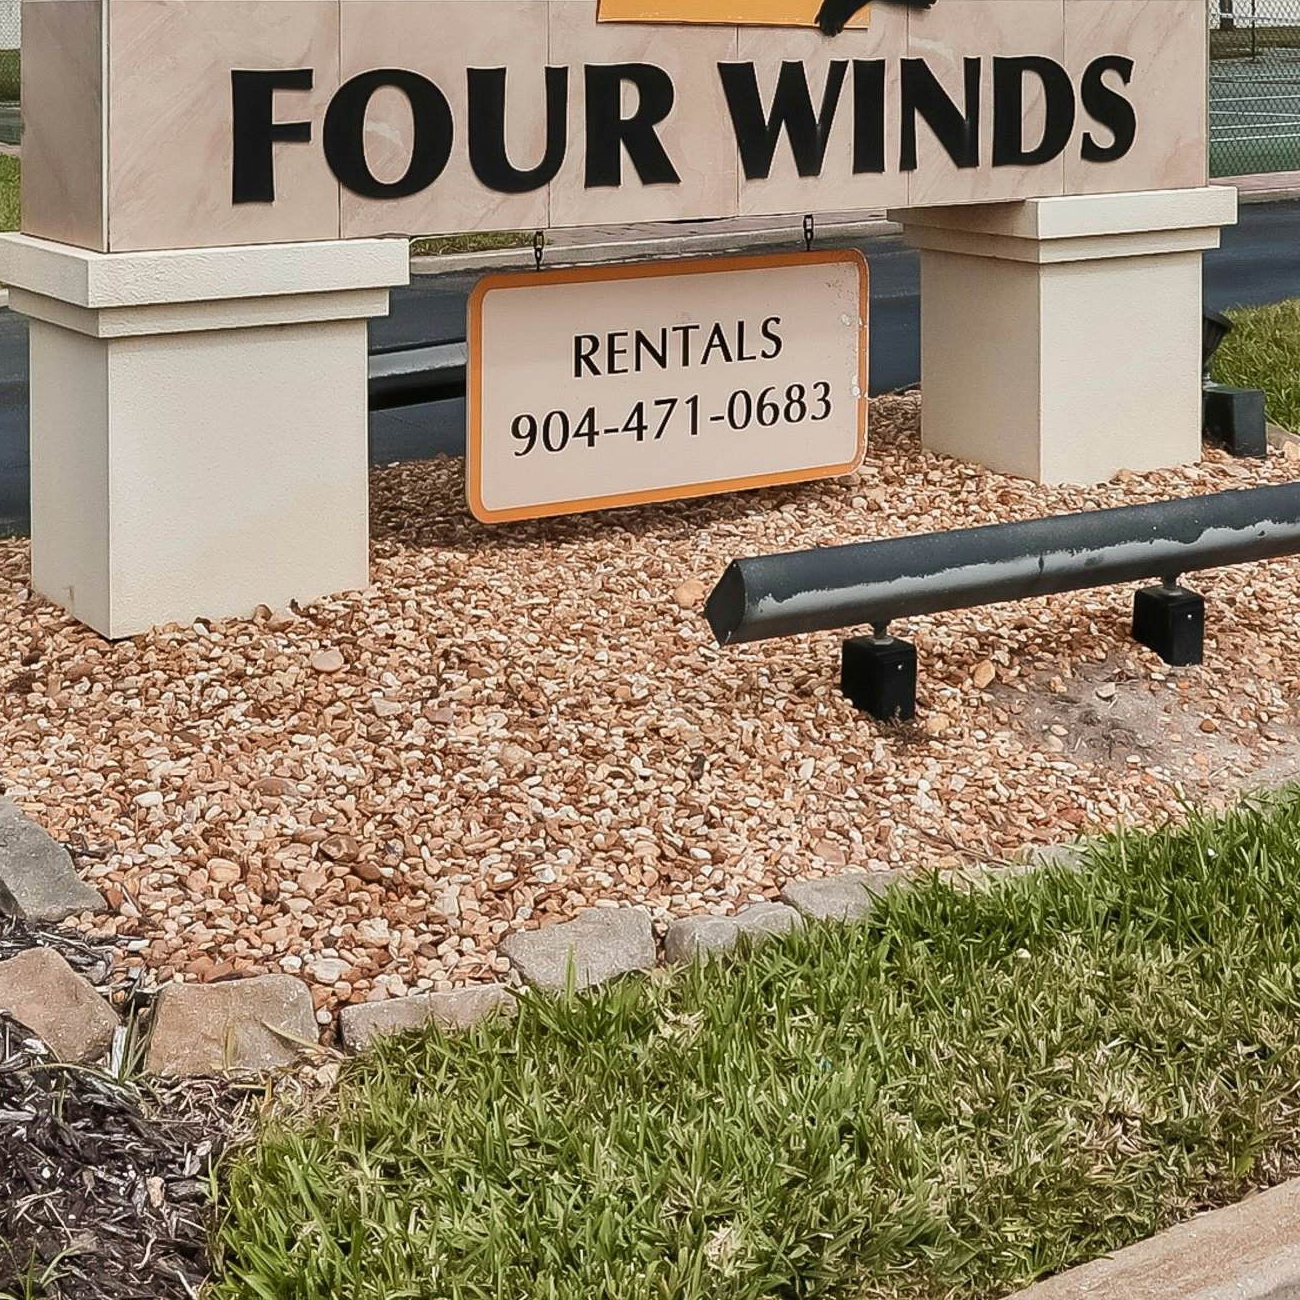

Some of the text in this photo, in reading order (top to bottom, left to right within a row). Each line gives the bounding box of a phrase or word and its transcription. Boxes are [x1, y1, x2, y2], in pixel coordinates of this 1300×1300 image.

[230, 54, 1138, 206] FOUR WINDS
[573, 315, 784, 379] RENTALS
[510, 380, 833, 458] 904-471-0683
